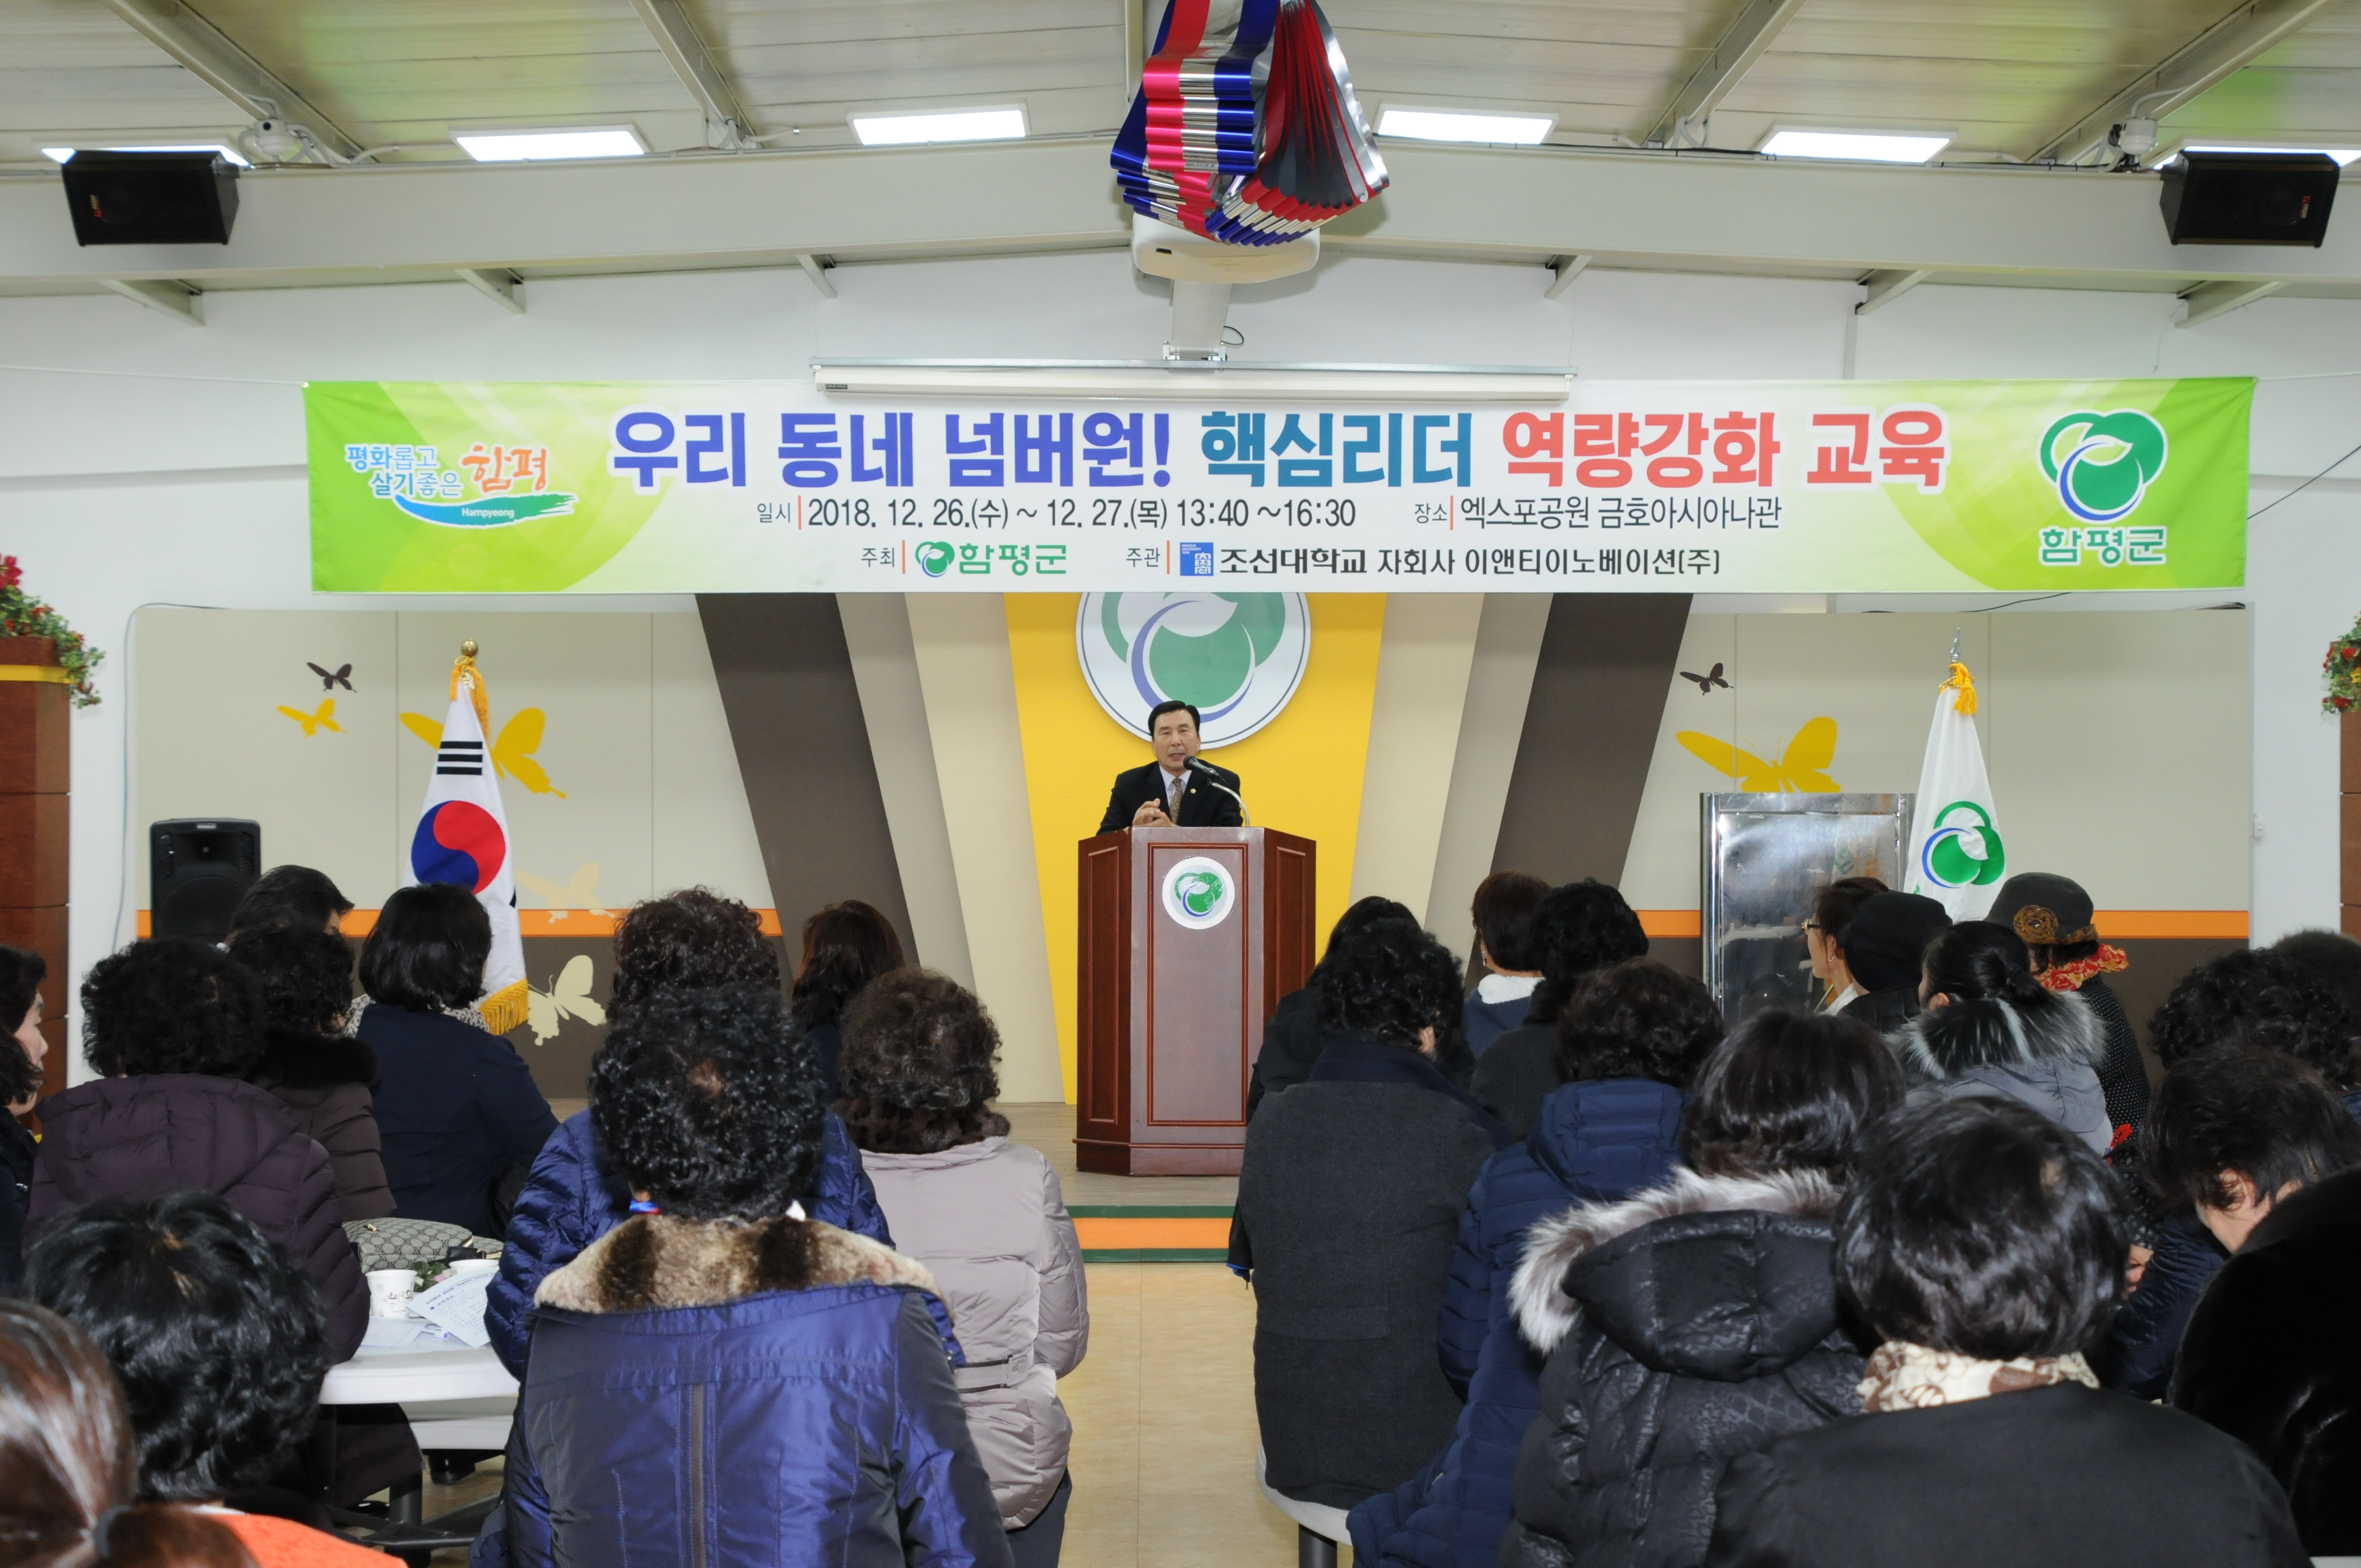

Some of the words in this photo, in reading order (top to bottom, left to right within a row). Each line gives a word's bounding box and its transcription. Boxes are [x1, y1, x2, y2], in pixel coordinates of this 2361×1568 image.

[347, 447, 437, 470] 평화롭고
[614, 412, 746, 487] 우리
[778, 412, 914, 488] 동네
[945, 412, 1171, 488] 넘버원!
[1201, 411, 1472, 487] 핵심리더
[1503, 411, 1781, 488] 역량강화
[1807, 410, 1945, 487] 교육
[371, 472, 461, 496] 살기좋은
[462, 445, 547, 493] 함평
[461, 508, 515, 518] Hampyeong
[757, 503, 791, 523] 일시
[808, 499, 877, 528] 2018.
[888, 499, 923, 528] 12.
[933, 498, 1009, 530] 26.(수)
[1047, 499, 1082, 528] 12.
[1092, 498, 1168, 530] 27.(목)
[1177, 499, 1249, 527] 13:40
[1415, 503, 1448, 524] 장소
[1461, 497, 1590, 530] 엑스포공원
[1598, 497, 1782, 529] 금호아시아나관
[861, 547, 895, 568] 주최
[959, 543, 1067, 576] 함평군
[1127, 548, 1161, 568] 주관
[1220, 548, 1368, 574] 조선대학교
[1378, 549, 1456, 575] 자회사
[2041, 528, 2164, 564] 함평군
